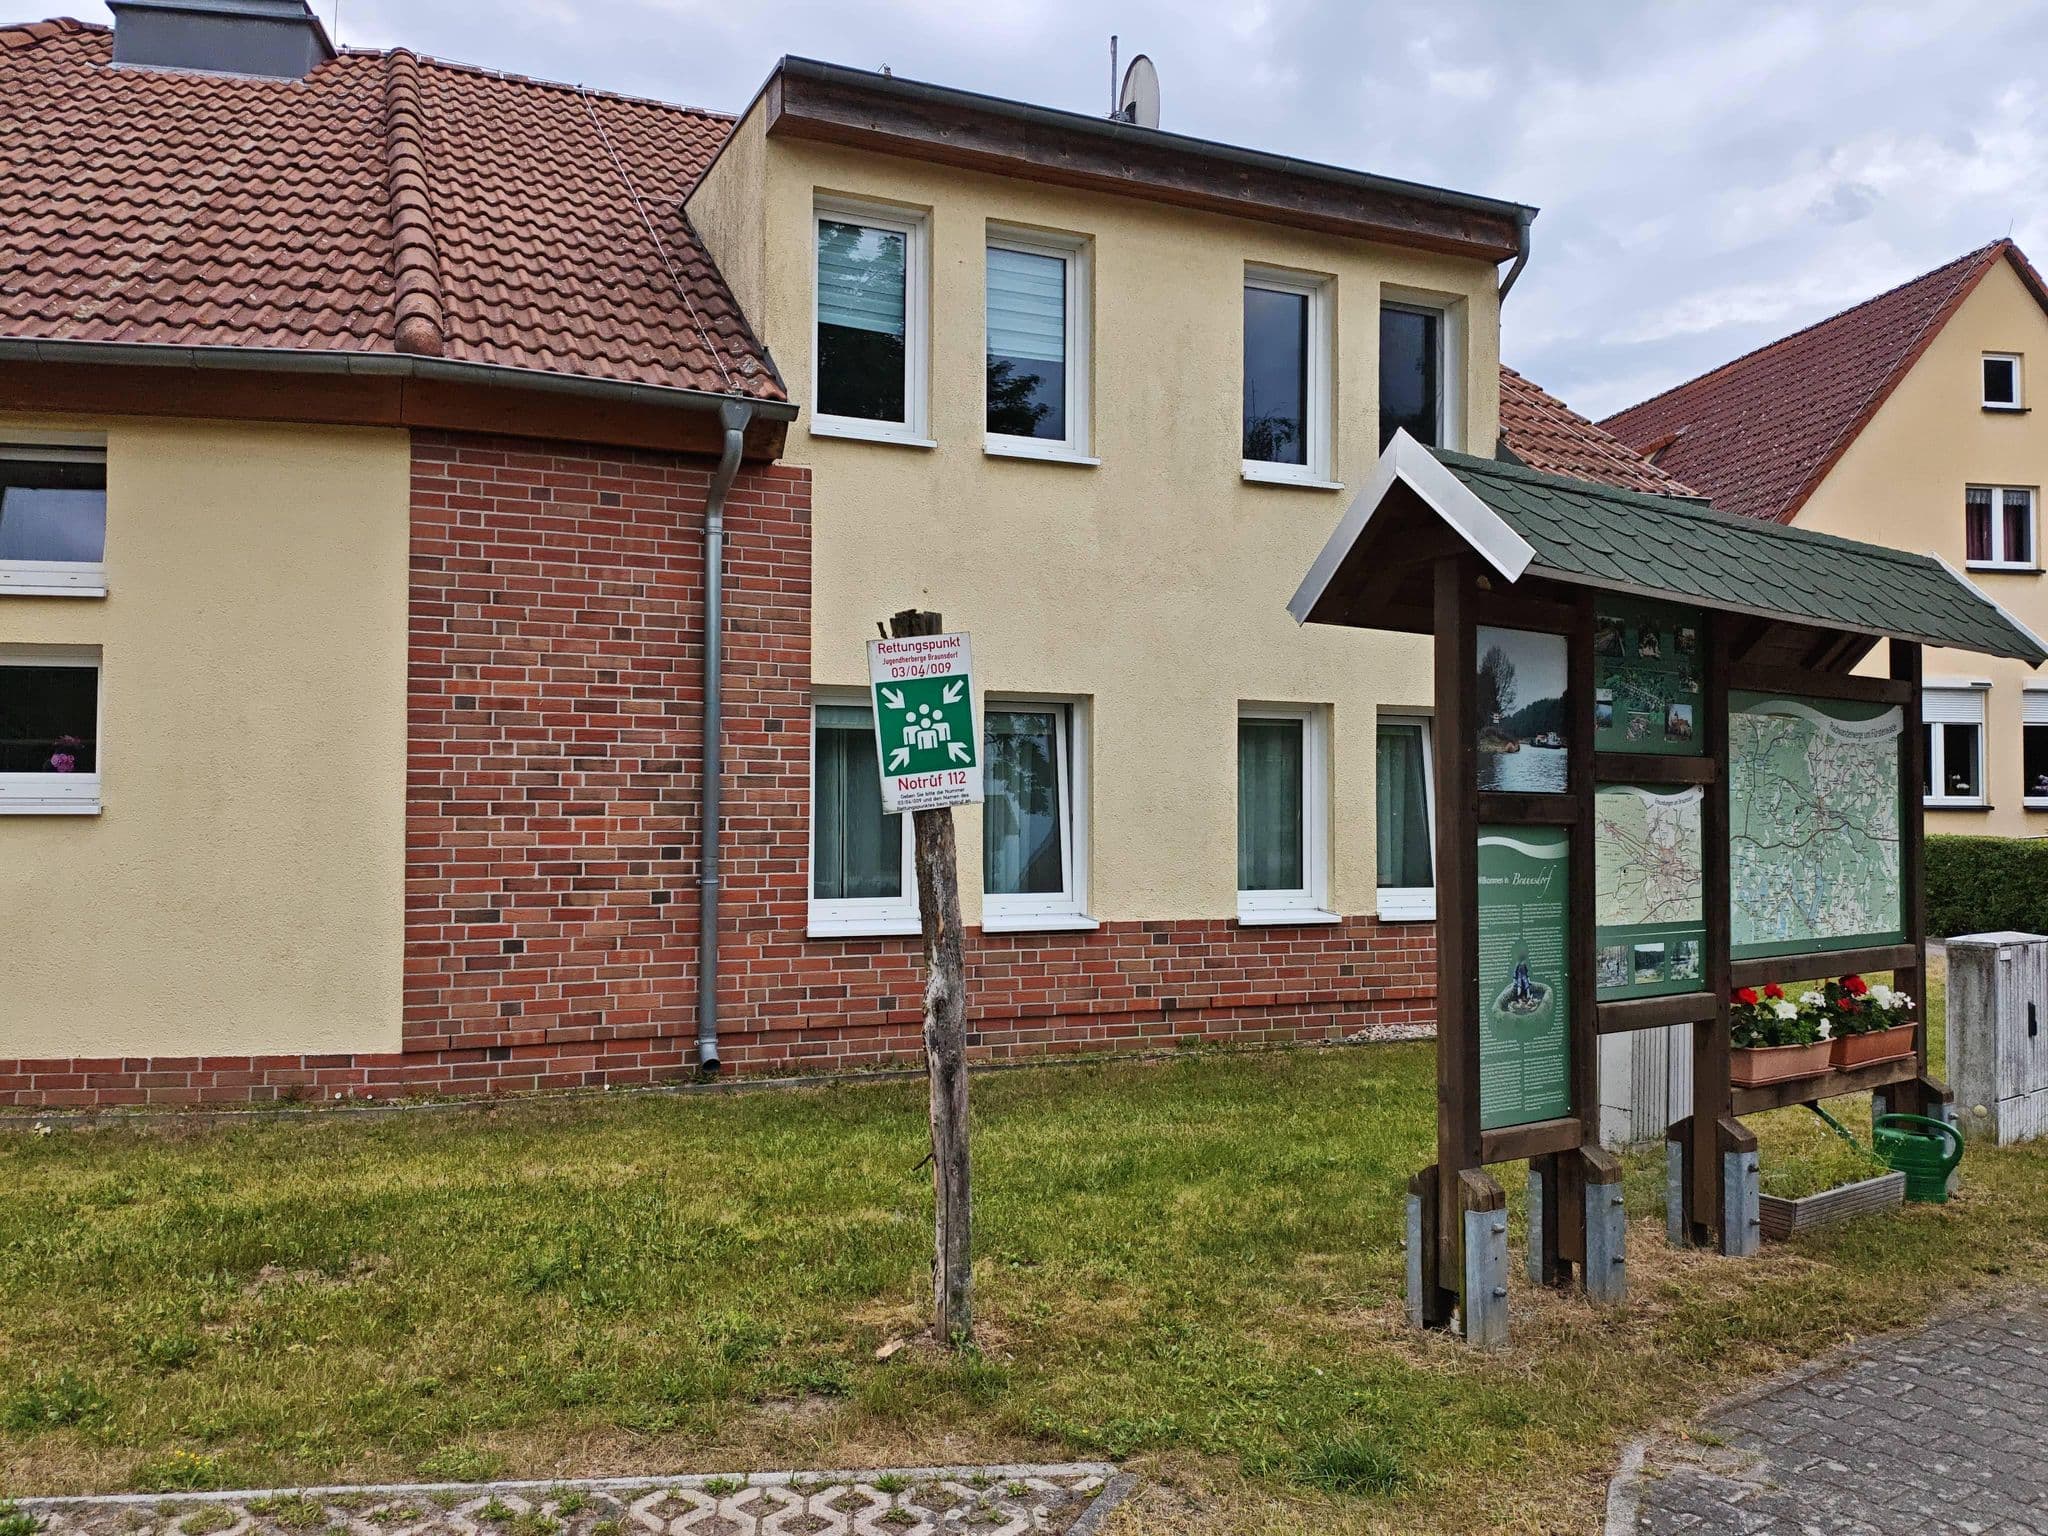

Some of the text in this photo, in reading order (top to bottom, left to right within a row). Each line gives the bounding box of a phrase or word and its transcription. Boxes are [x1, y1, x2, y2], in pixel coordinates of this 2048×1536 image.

[878, 636, 960, 654] Rettungspunkt
[883, 651, 958, 665] Jugendherberge Braunsdorf
[891, 662, 952, 678] 03/04/009
[898, 771, 966, 791] Notruf 112
